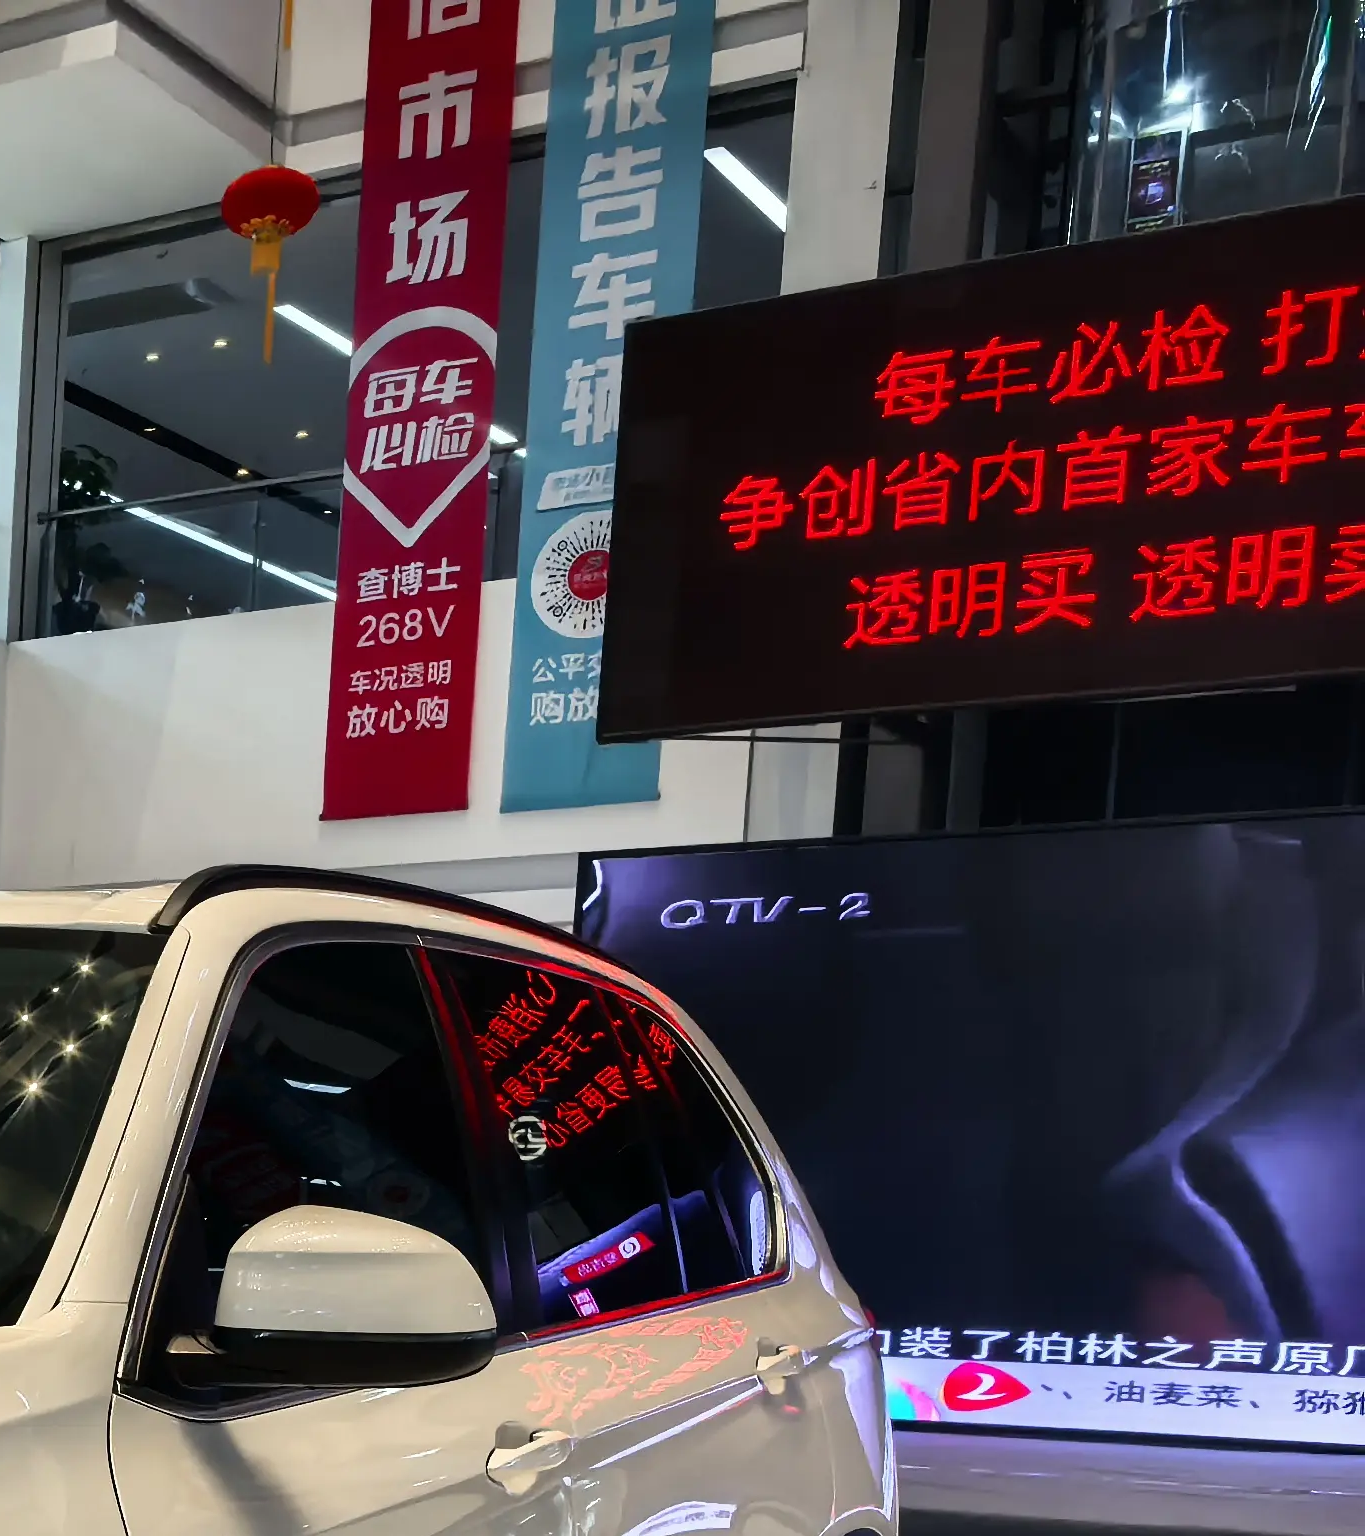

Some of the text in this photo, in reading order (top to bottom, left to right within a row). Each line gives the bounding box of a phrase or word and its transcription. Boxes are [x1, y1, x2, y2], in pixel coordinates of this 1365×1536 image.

[873, 285, 1365, 425] 每车必检 打
[359, 412, 475, 475] 必检
[356, 556, 461, 604] 查博士
[843, 547, 1097, 650] 透明买
[356, 604, 456, 648] 268V
[348, 659, 452, 695] 车况透明
[346, 695, 450, 740] 放心购
[877, 1327, 1365, 1377] 装了柏林之声原
